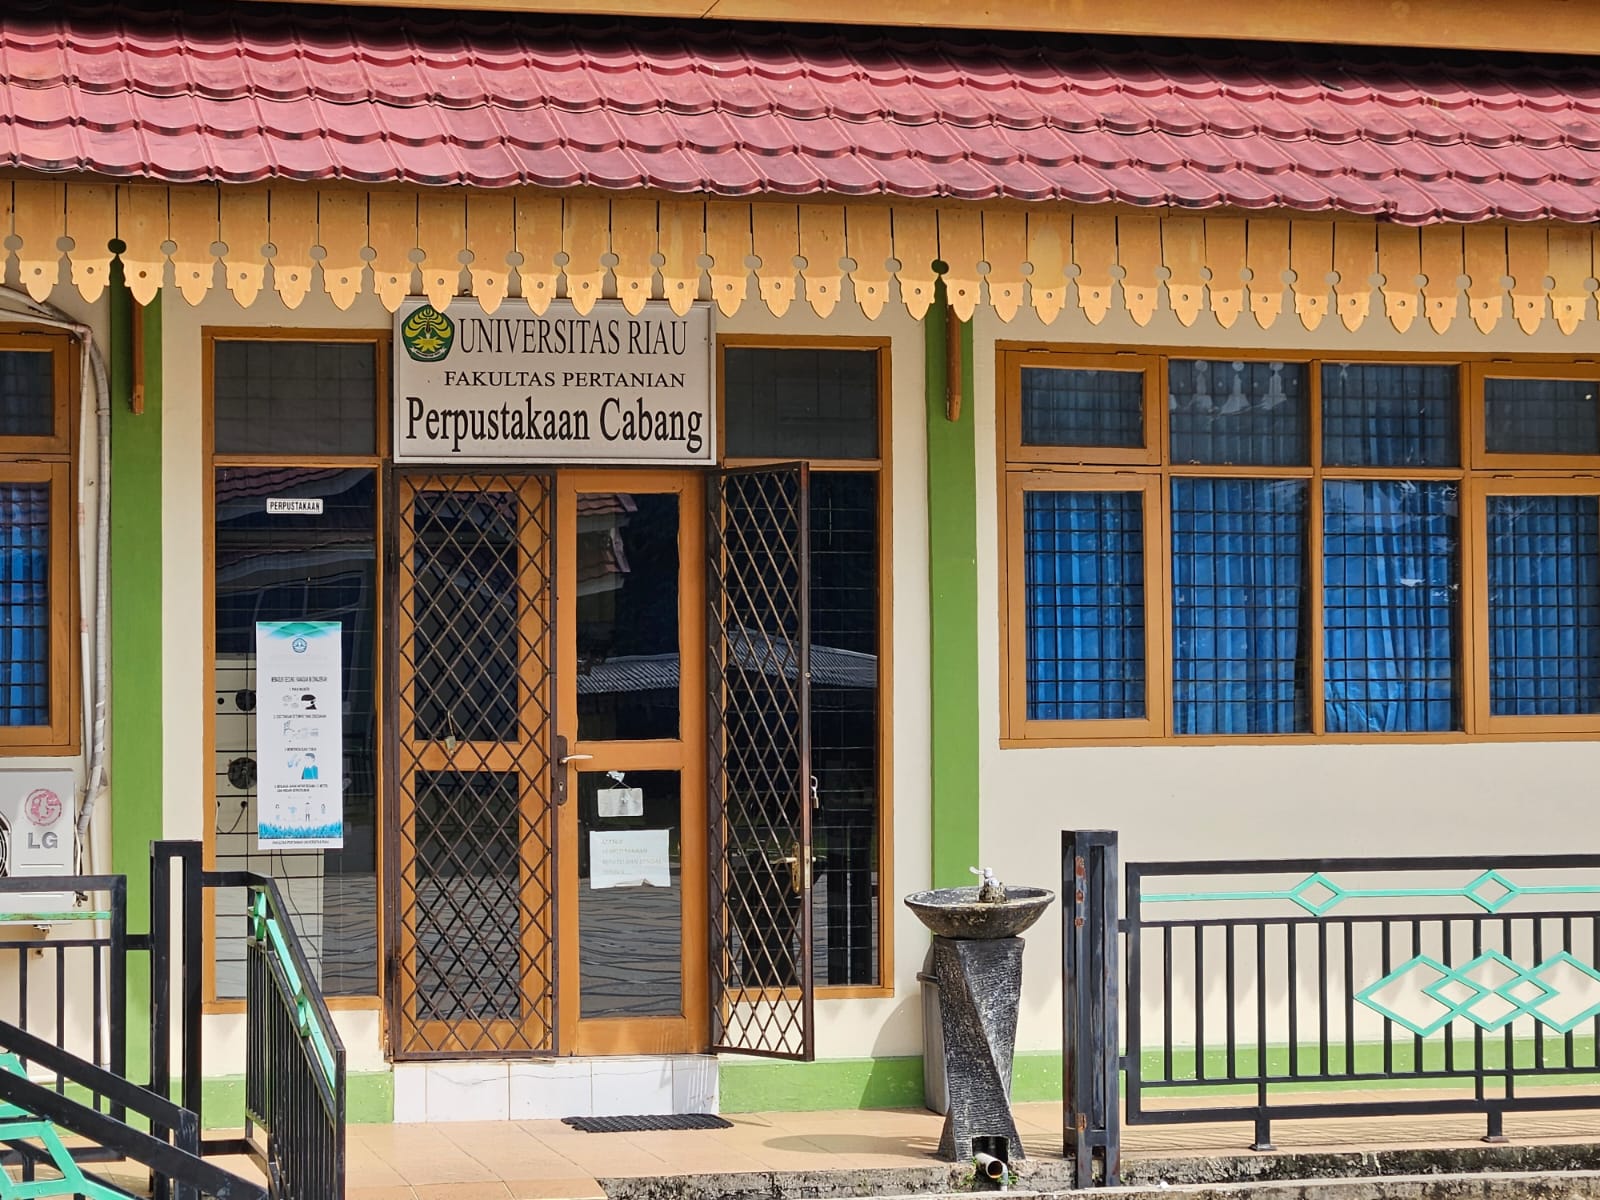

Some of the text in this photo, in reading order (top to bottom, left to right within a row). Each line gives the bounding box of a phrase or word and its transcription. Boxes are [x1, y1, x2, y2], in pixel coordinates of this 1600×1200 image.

[458, 318, 688, 356] UNIVERSITAS RIAU
[444, 371, 686, 388] FAKULTAS PERTANIAN
[405, 396, 703, 454] Perpustakaan Cabang
[269, 501, 320, 511] PERPUSTAKAAN
[27, 831, 58, 849] LG
